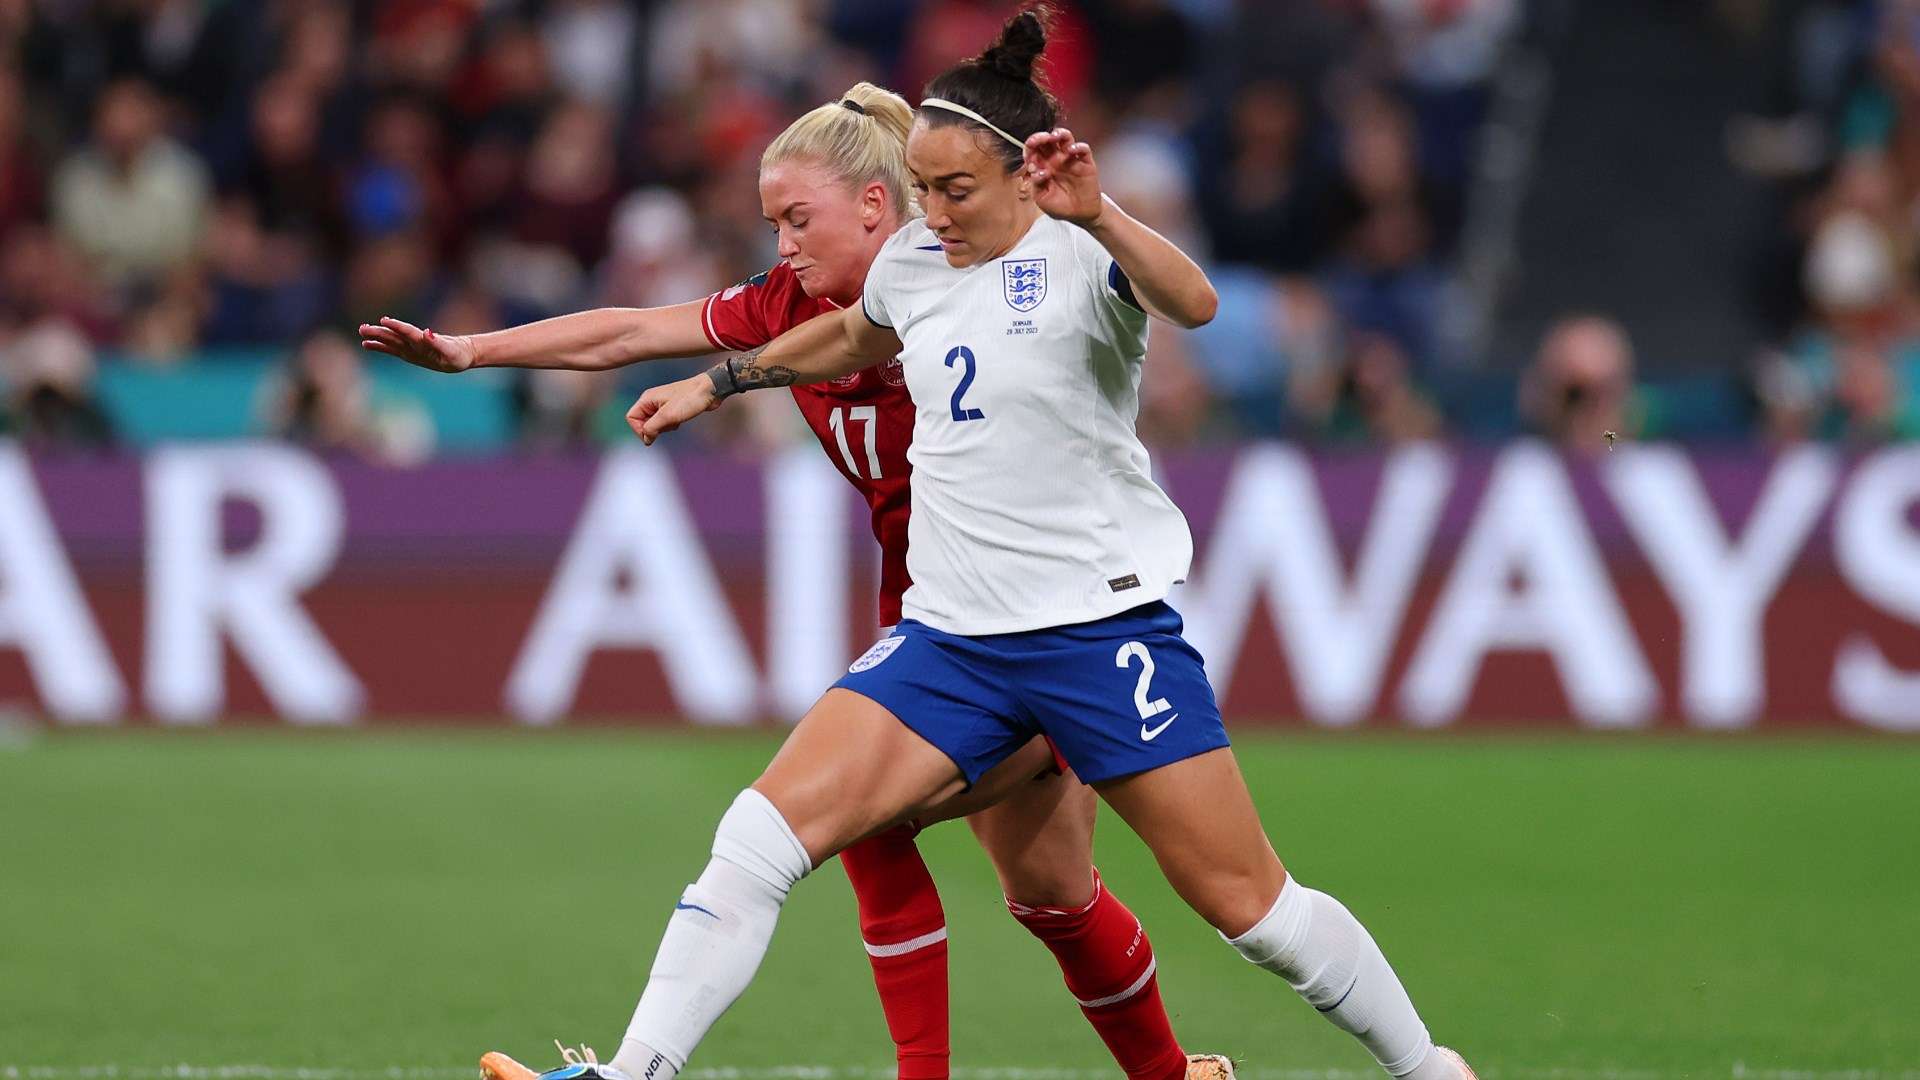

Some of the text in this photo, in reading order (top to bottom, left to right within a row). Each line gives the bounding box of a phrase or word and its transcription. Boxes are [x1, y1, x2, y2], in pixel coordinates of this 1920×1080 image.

[944, 345, 985, 422] 2
[828, 405, 883, 480] 17
[1115, 640, 1172, 720] 2
